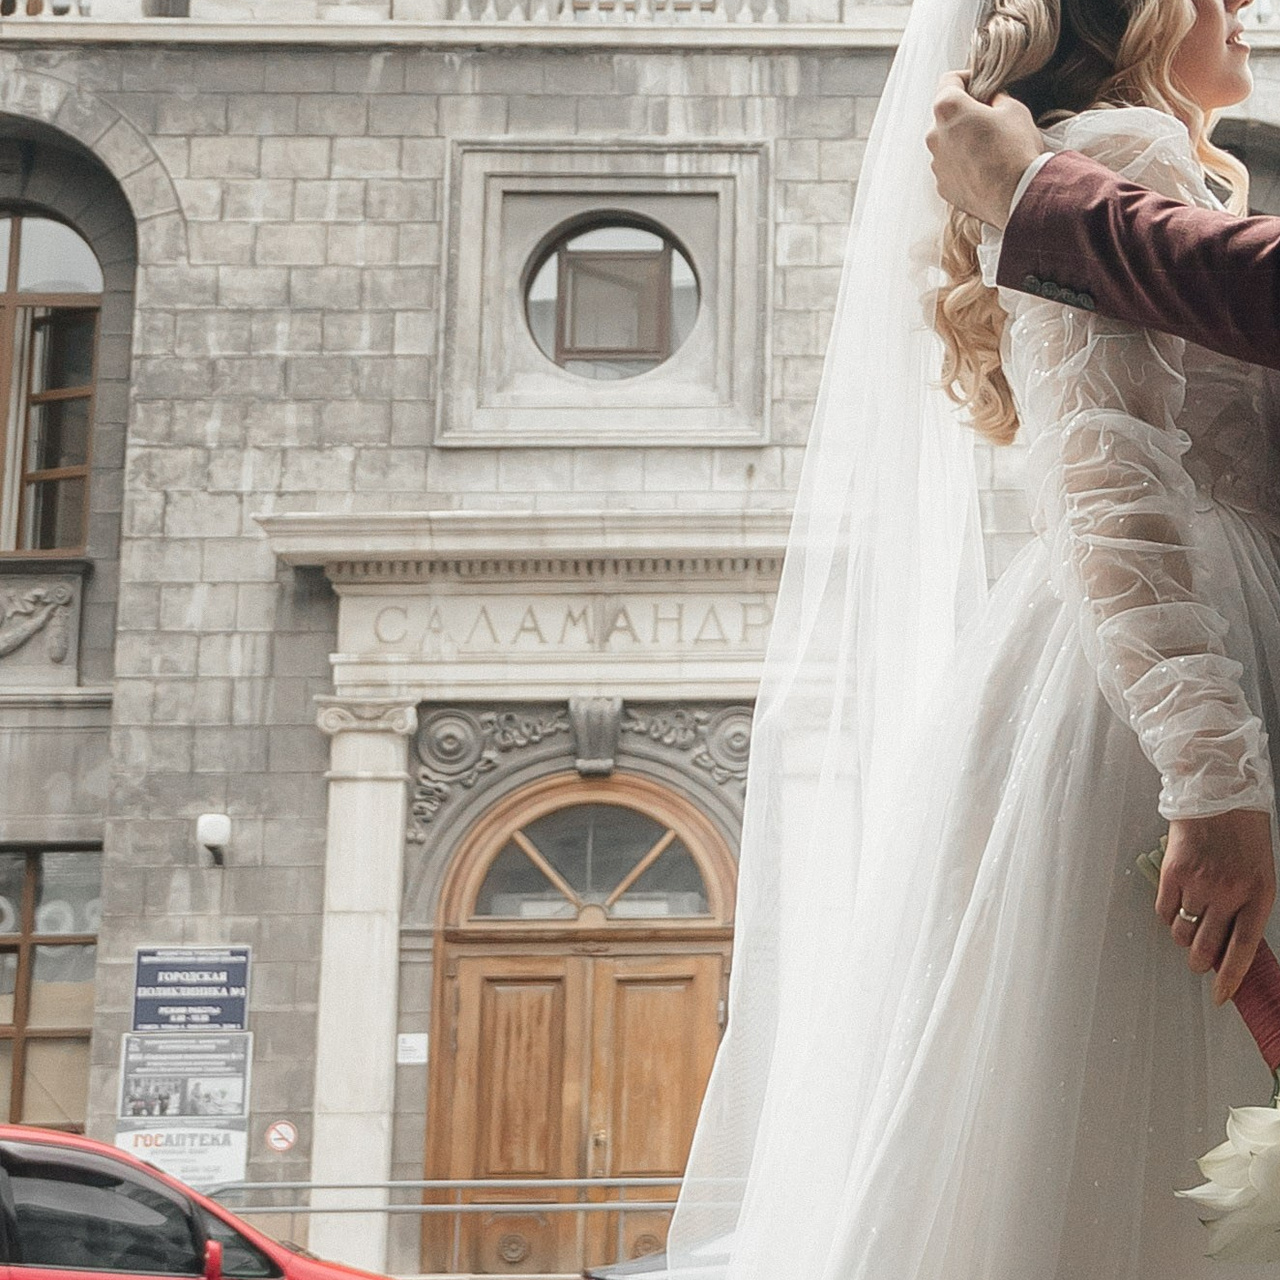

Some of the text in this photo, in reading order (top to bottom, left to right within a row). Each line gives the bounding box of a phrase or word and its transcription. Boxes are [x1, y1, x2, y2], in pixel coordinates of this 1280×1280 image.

[373, 601, 773, 646] САЛАМАНДР
[157, 971, 228, 983] ГОРОДСКАЯ
[133, 1133, 232, 1148] ГОСАПТЕКА
